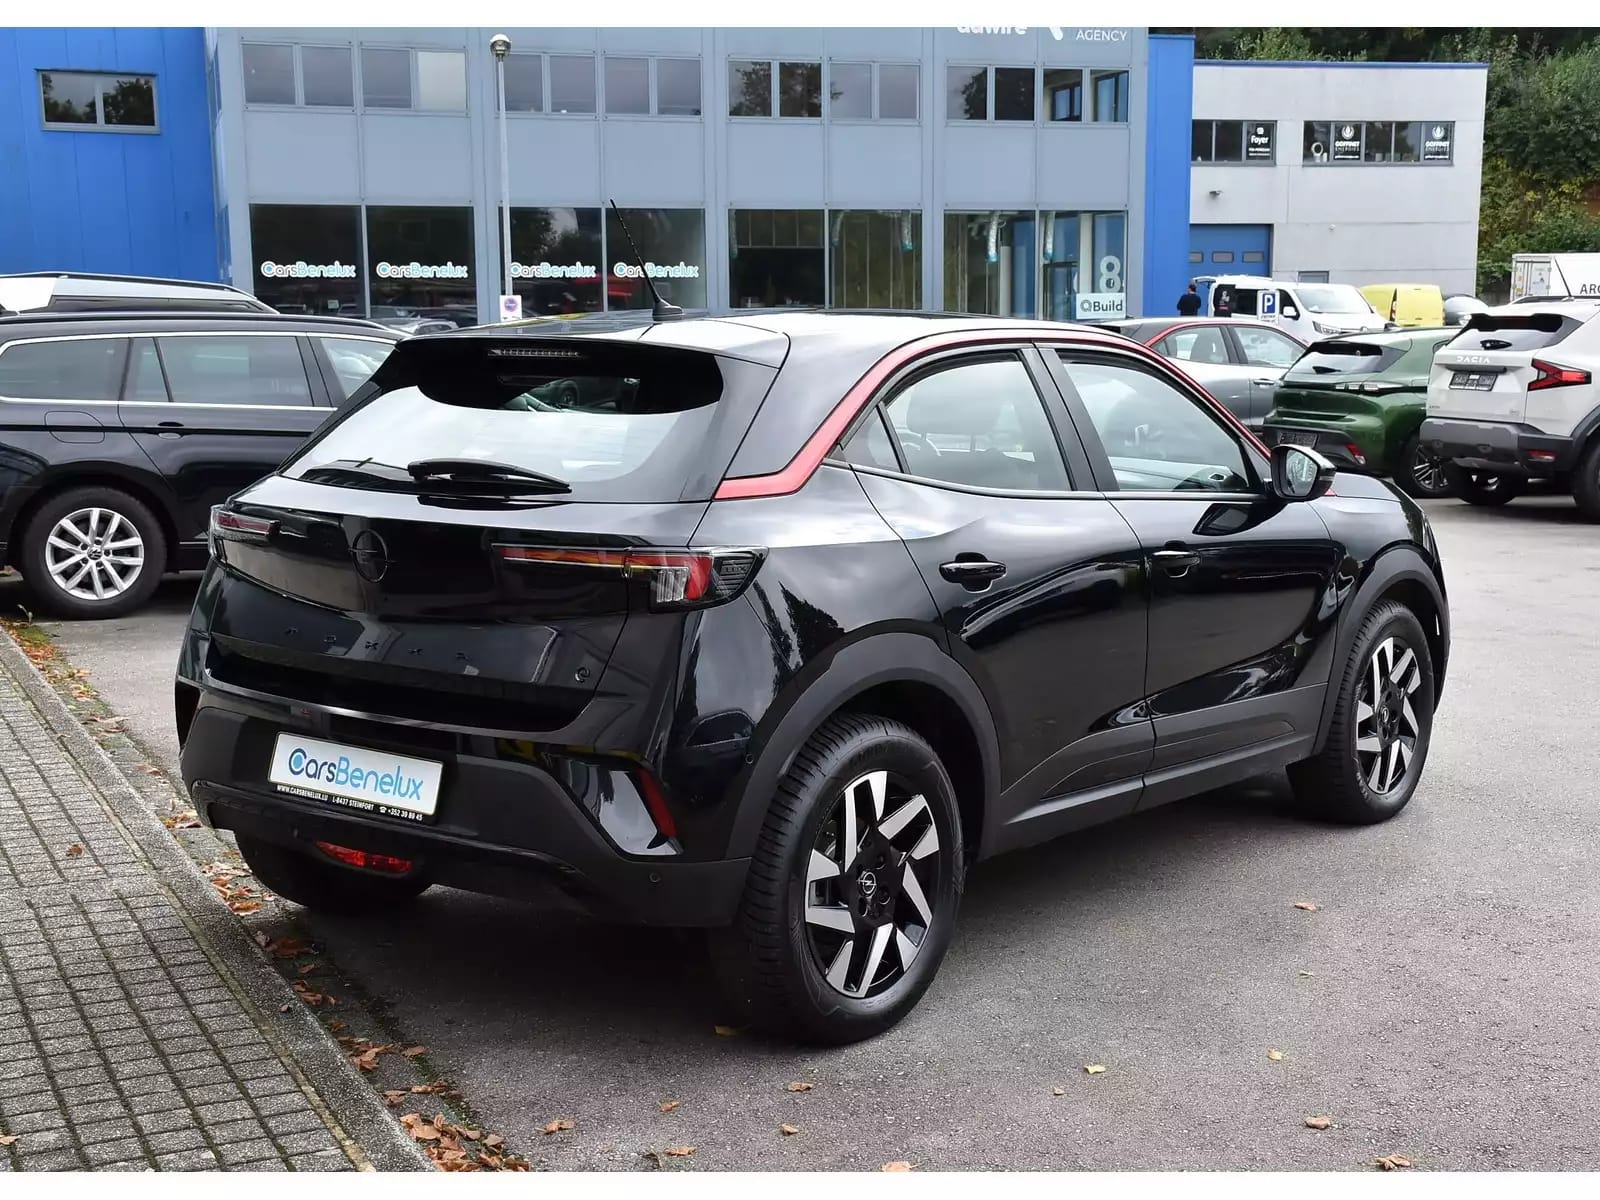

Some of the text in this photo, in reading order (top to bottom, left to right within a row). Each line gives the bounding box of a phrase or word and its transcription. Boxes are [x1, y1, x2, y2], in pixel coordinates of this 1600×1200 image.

[1075, 29, 1128, 42] AGENCY
[1250, 135, 1269, 145] Foyer
[261, 260, 356, 278] CarsBenelux
[376, 261, 469, 279] CarsBenelux
[510, 261, 596, 278] CarsBenelux
[1080, 299, 1123, 313] QBuild
[1264, 294, 1274, 313] P
[1456, 355, 1491, 364] DACIA
[288, 747, 424, 801] CarsBenelux
